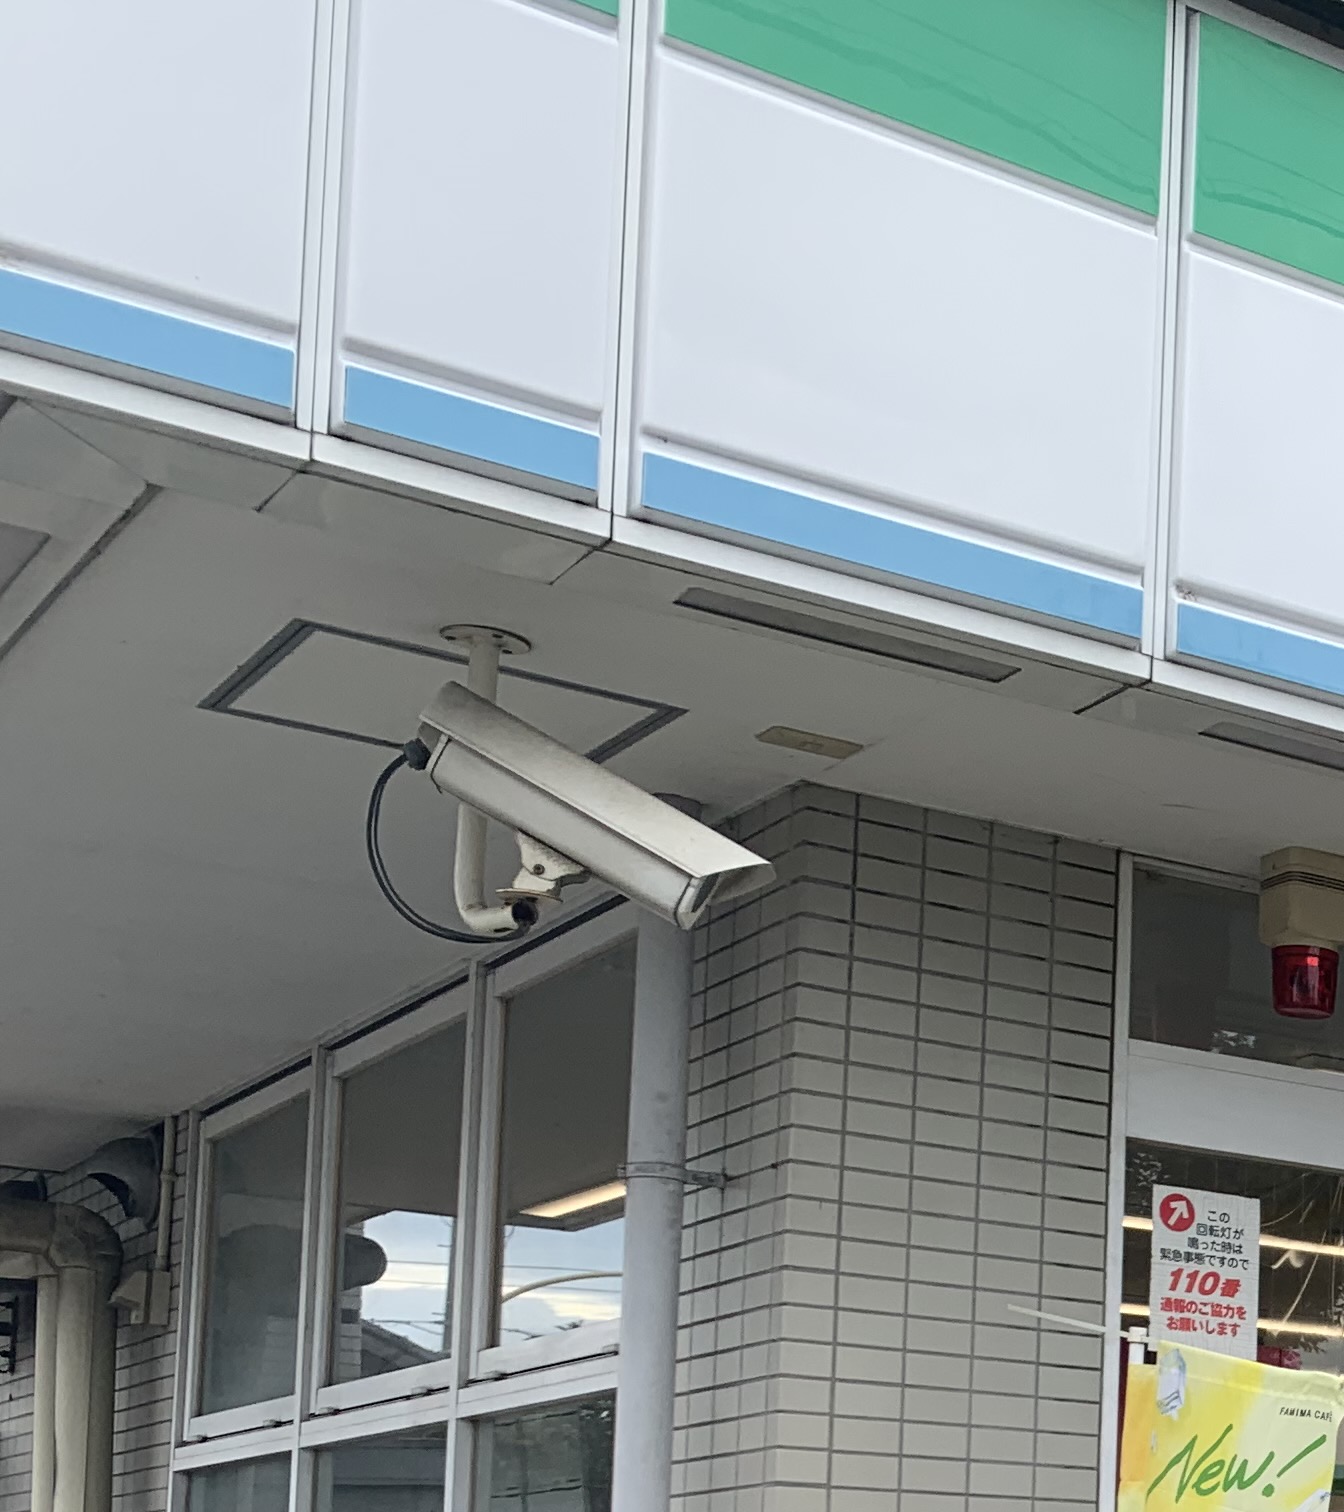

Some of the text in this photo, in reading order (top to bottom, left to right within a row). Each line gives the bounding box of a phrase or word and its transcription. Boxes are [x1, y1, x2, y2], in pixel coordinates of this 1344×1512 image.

[1207, 1210, 1230, 1223] この
[1196, 1223, 1244, 1239] 回転灯が
[1187, 1237, 1243, 1254] 鳴った時は
[1160, 1248, 1249, 1270] 緊急事態ですので
[1168, 1267, 1241, 1298] 110番
[1160, 1297, 1247, 1320] 通報のご協力を
[1166, 1316, 1241, 1337] お願いします
[1279, 1406, 1311, 1417] FAMIMA
[1147, 1424, 1326, 1504] New!
